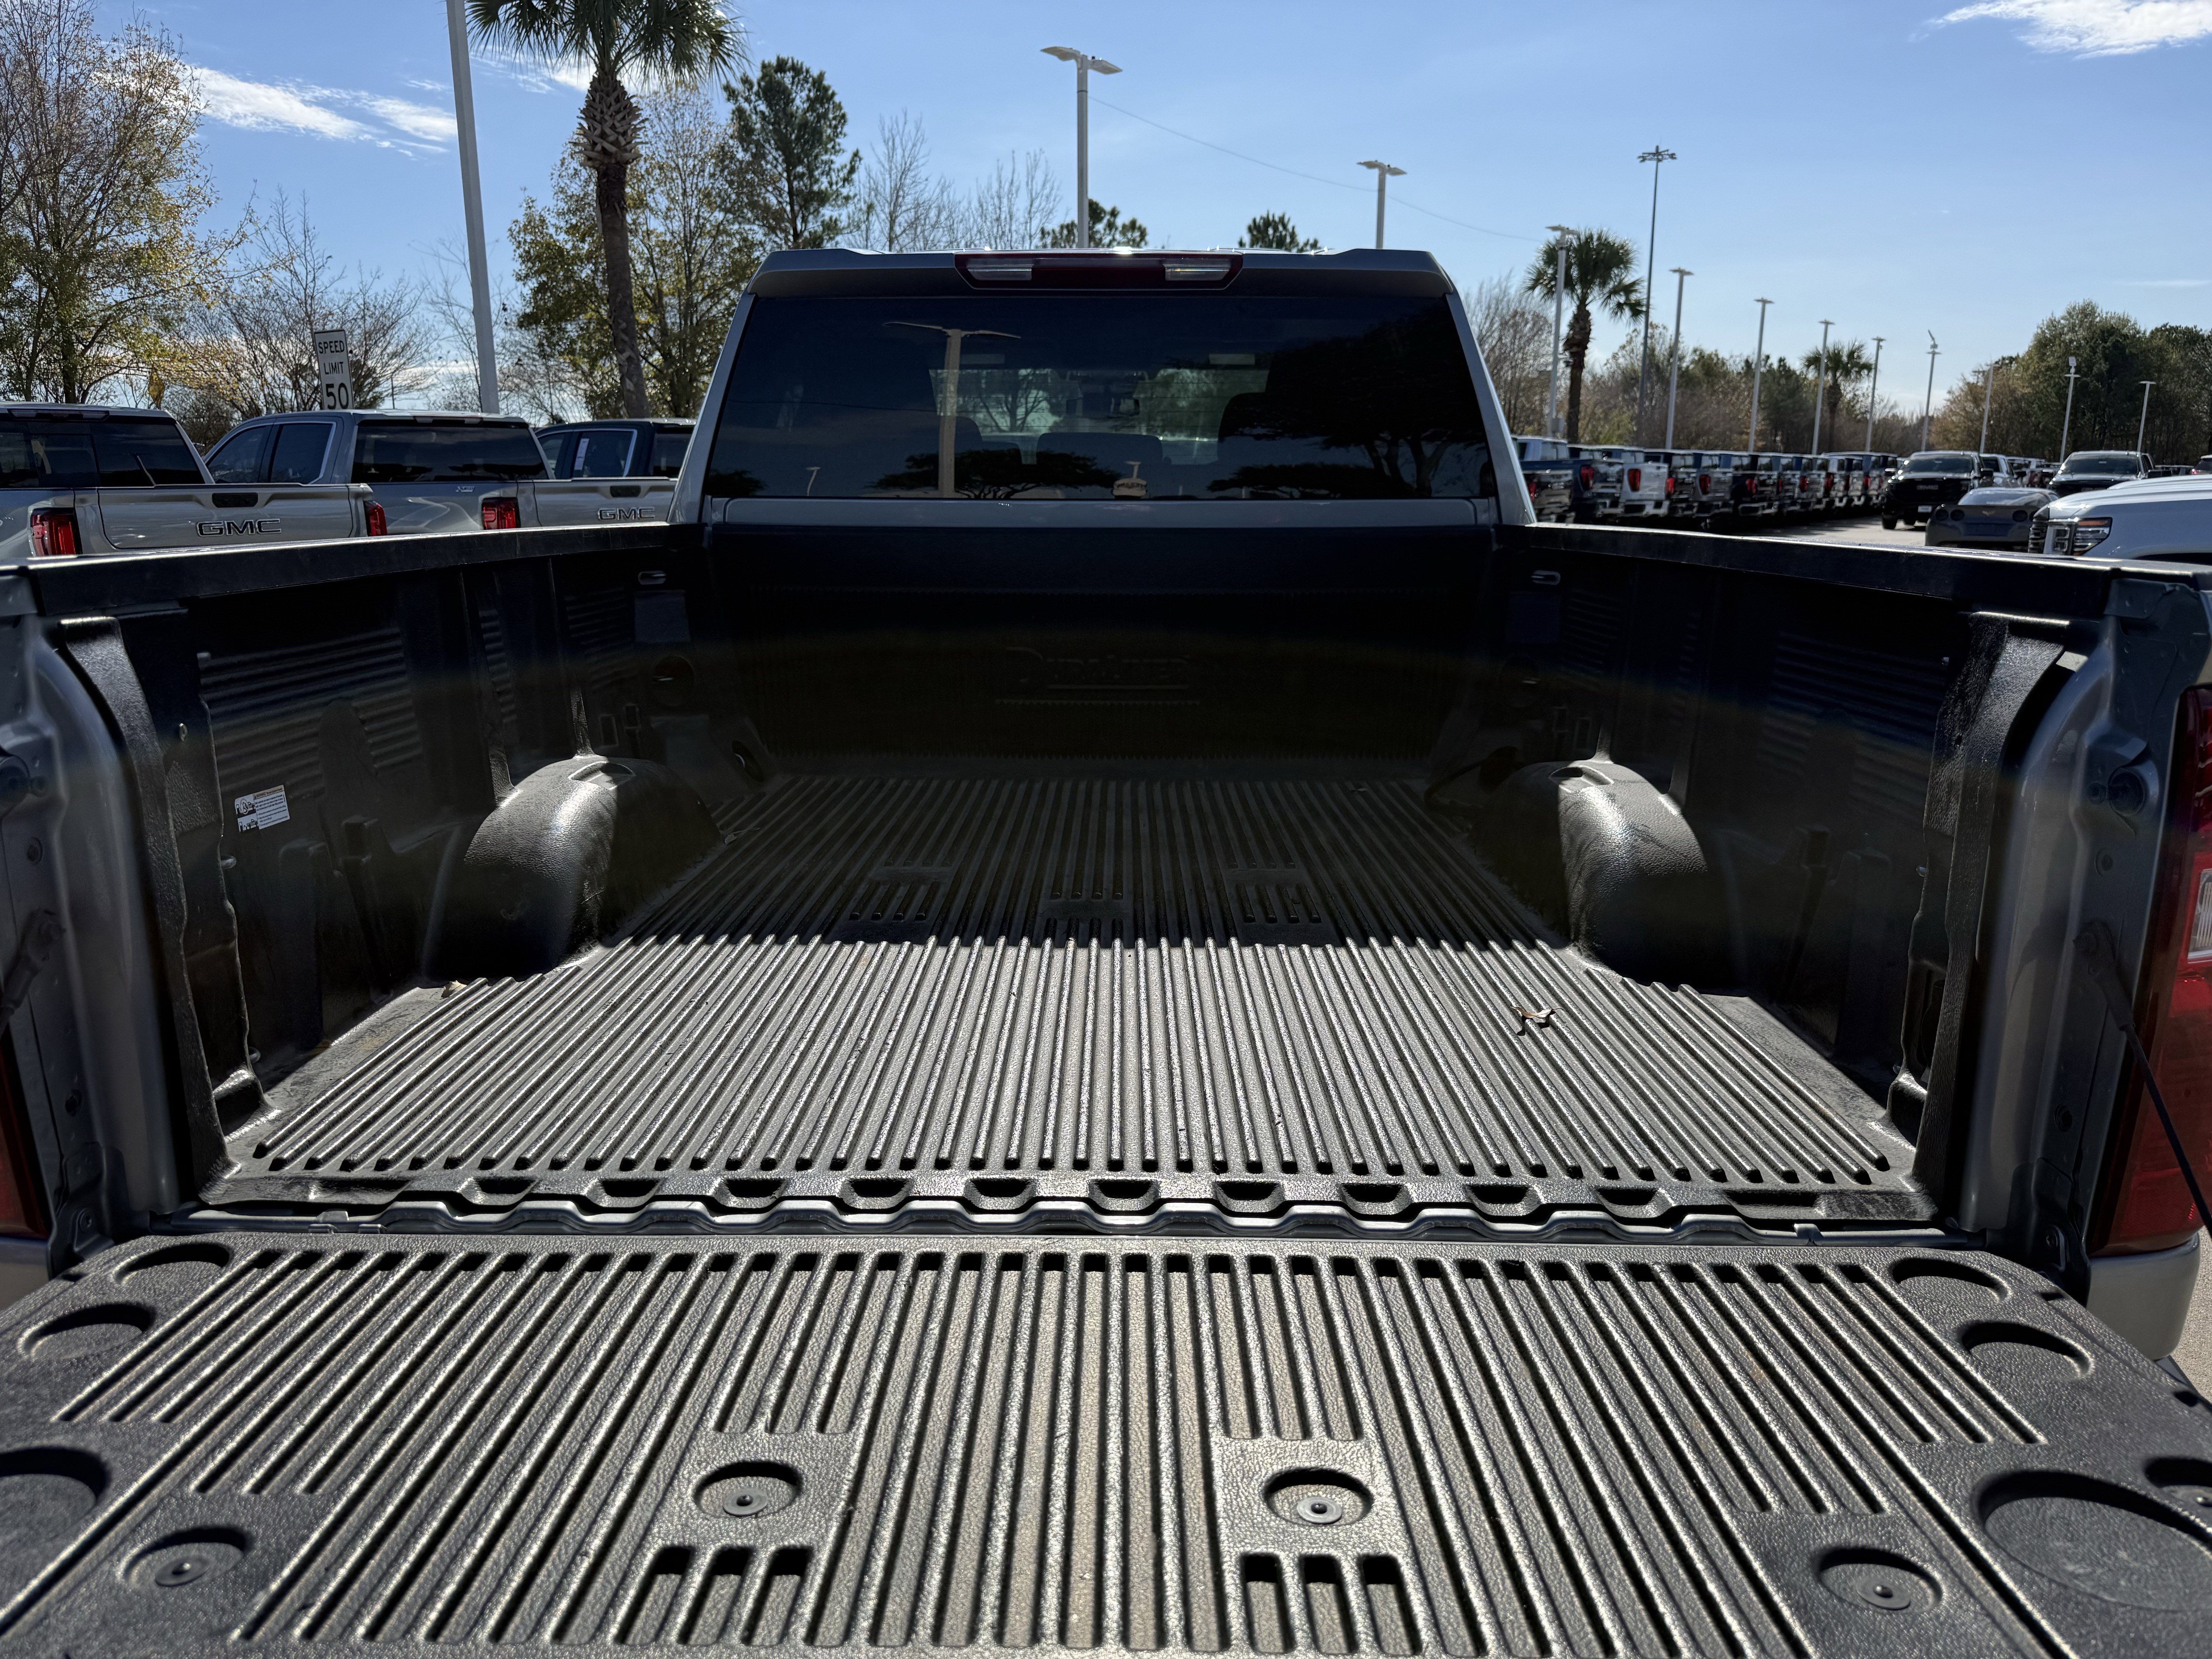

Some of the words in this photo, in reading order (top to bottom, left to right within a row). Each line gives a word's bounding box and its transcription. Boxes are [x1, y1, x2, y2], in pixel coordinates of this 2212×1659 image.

[318, 340, 345, 354] SPEED
[324, 362, 343, 374] LIMIT
[326, 383, 349, 409] 50
[598, 507, 655, 520] GMC
[196, 518, 282, 537] GMC
